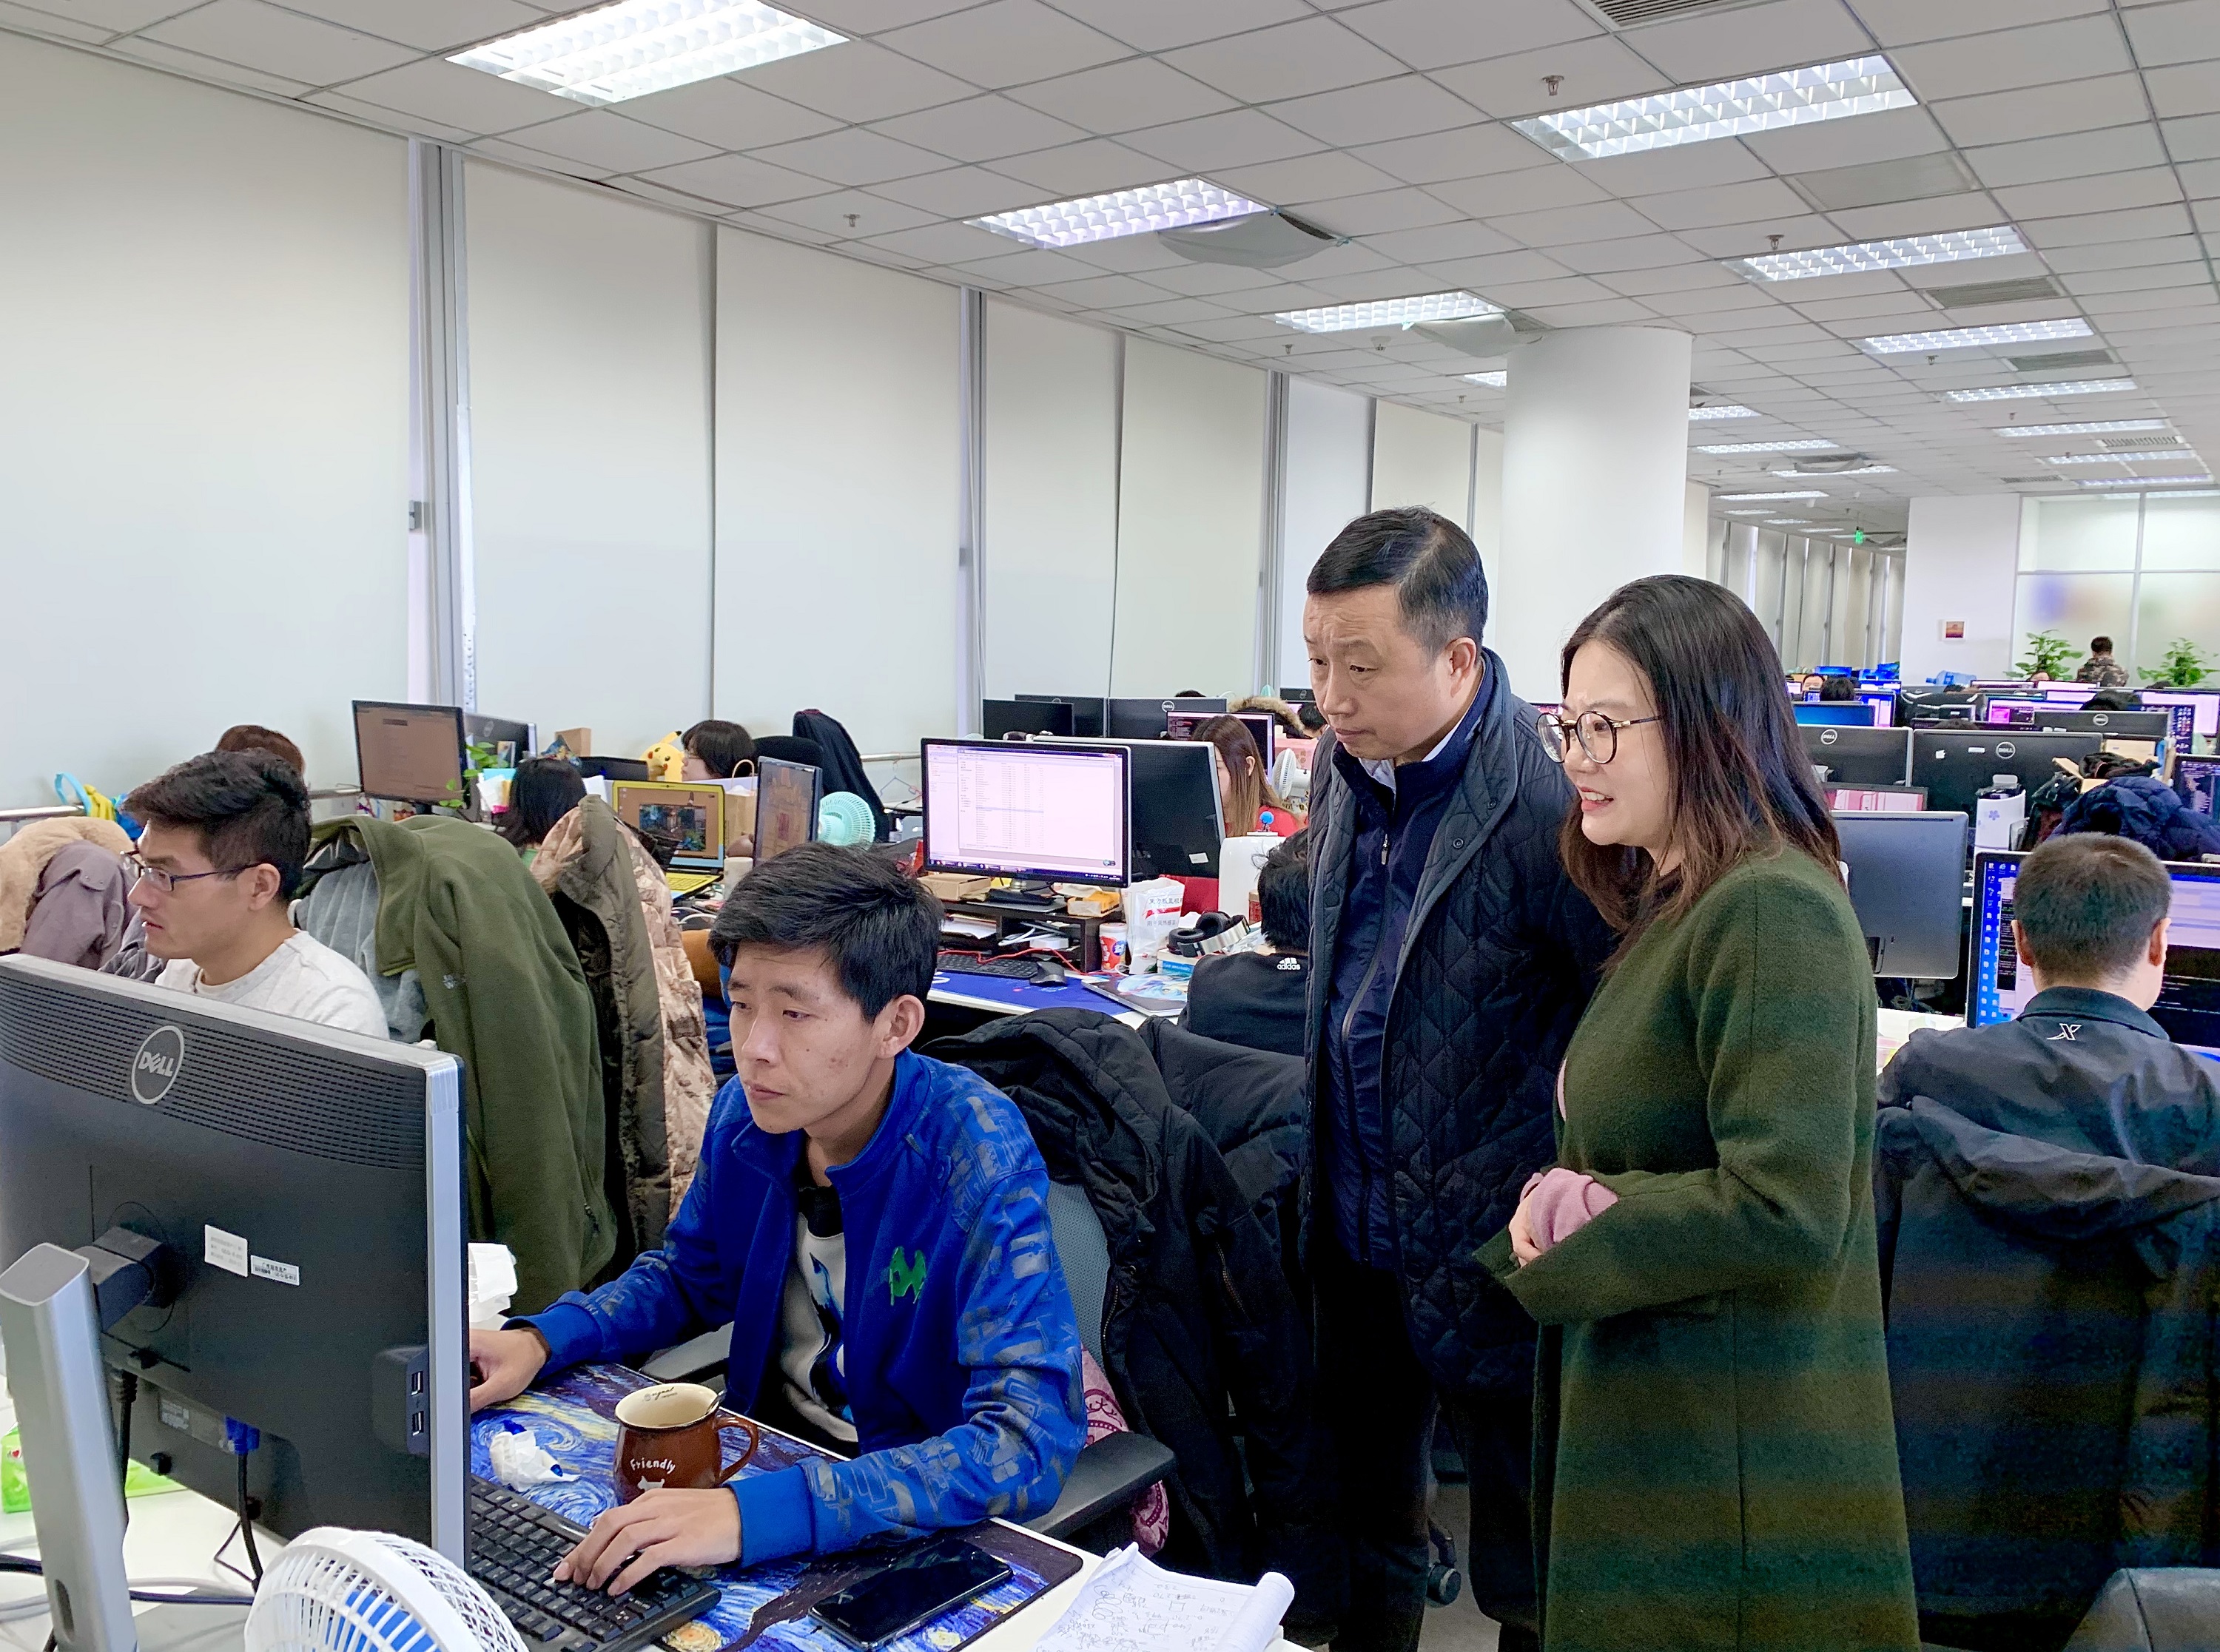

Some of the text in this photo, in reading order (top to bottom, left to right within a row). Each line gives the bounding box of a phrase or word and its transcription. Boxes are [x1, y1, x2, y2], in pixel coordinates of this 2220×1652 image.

[1276, 962, 1301, 971] adidas
[138, 1051, 175, 1077] DELL
[630, 1457, 676, 1474] Friendly
